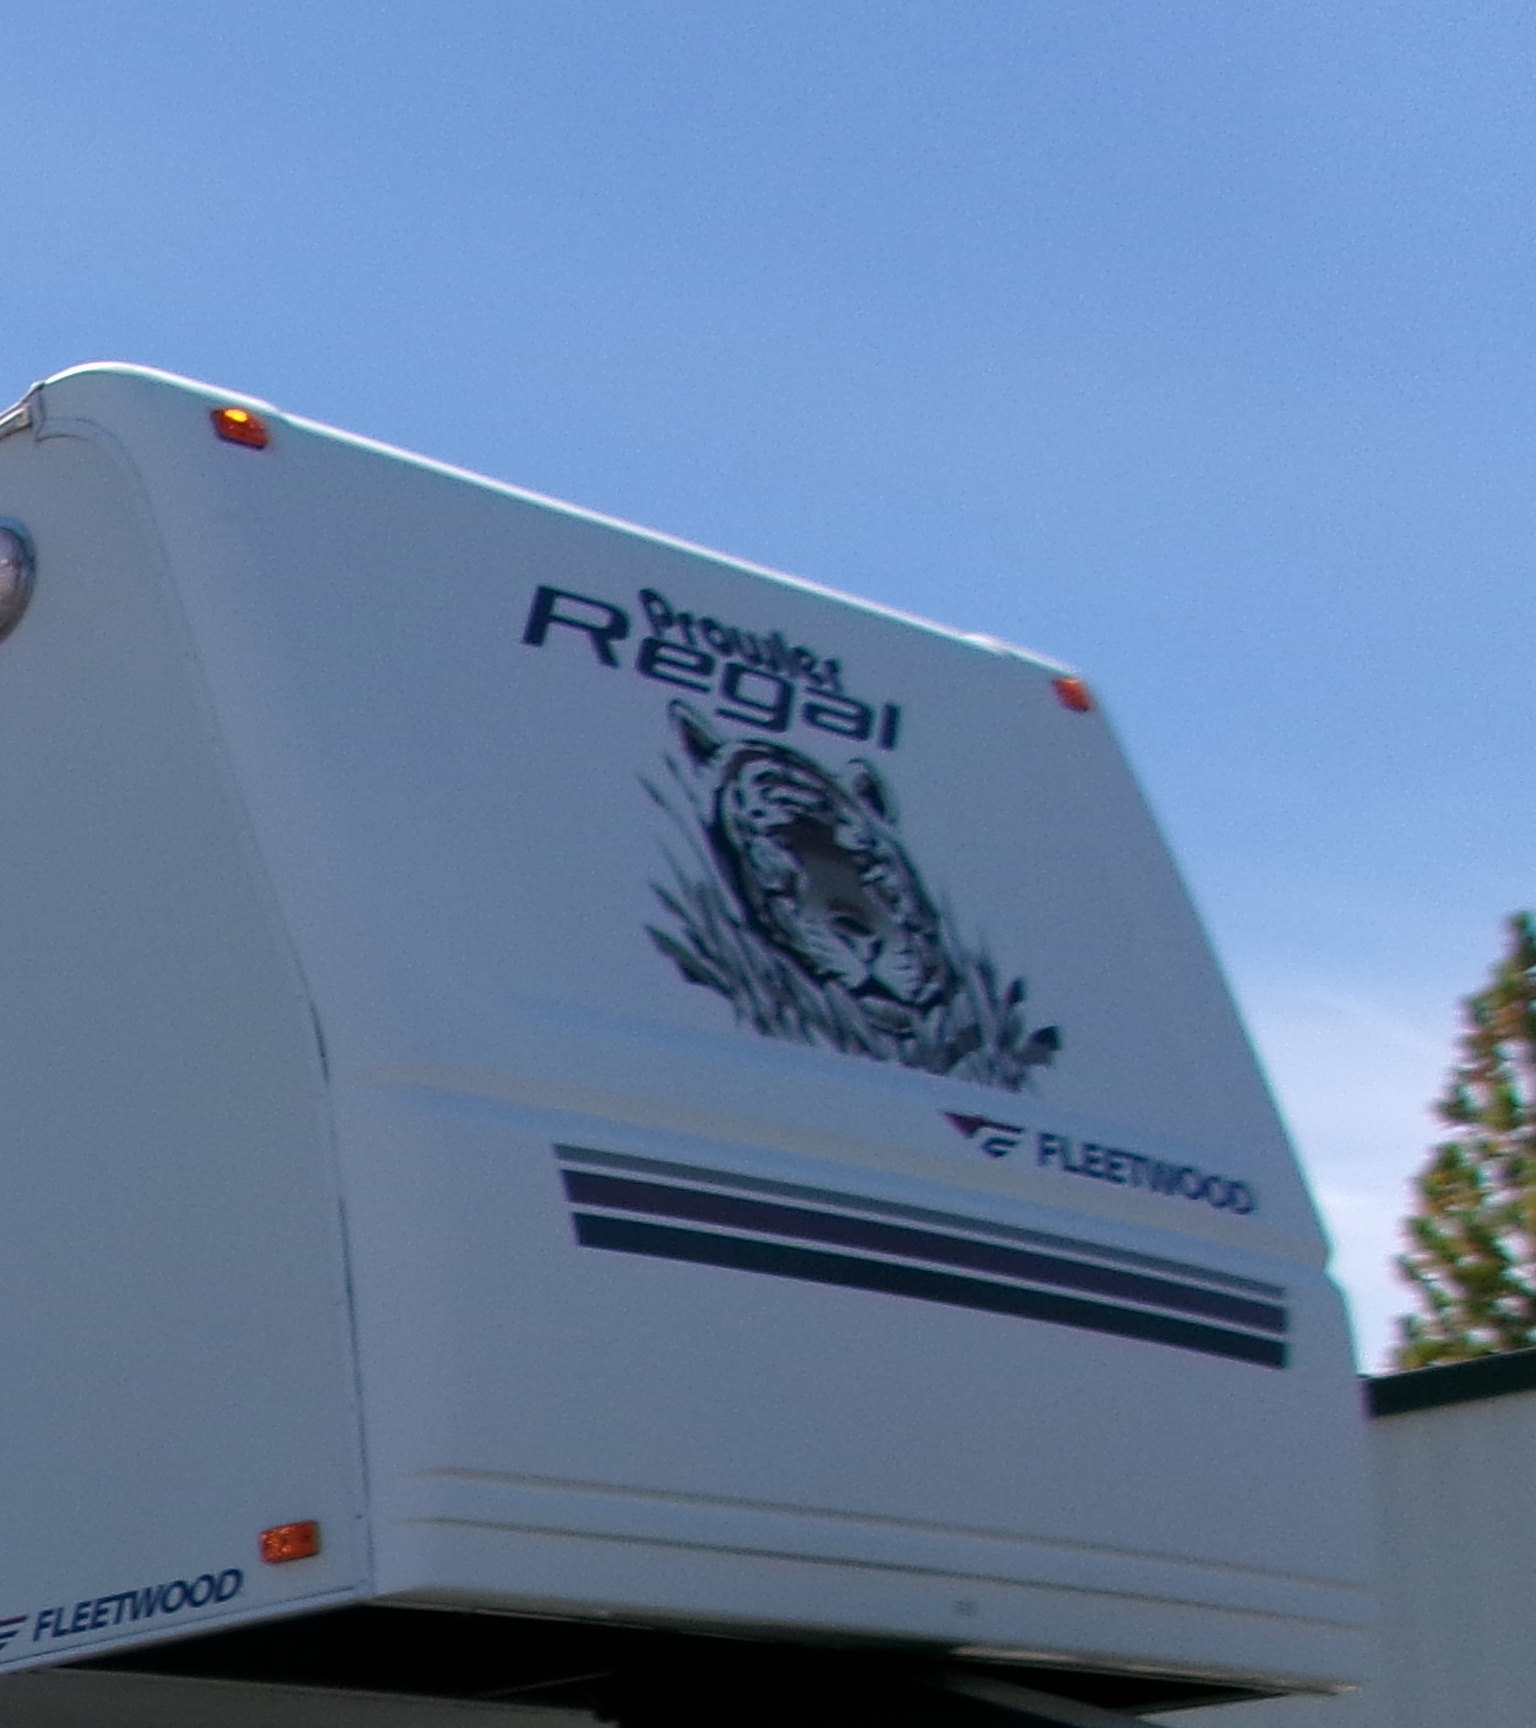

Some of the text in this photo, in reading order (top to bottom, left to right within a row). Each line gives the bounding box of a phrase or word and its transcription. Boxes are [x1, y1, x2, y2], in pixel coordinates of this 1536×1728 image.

[522, 584, 902, 752] Regal
[638, 587, 845, 694] Prowler
[1036, 1131, 1259, 1215] FLEETWOOD
[32, 1568, 244, 1642] FLEETWOOD
